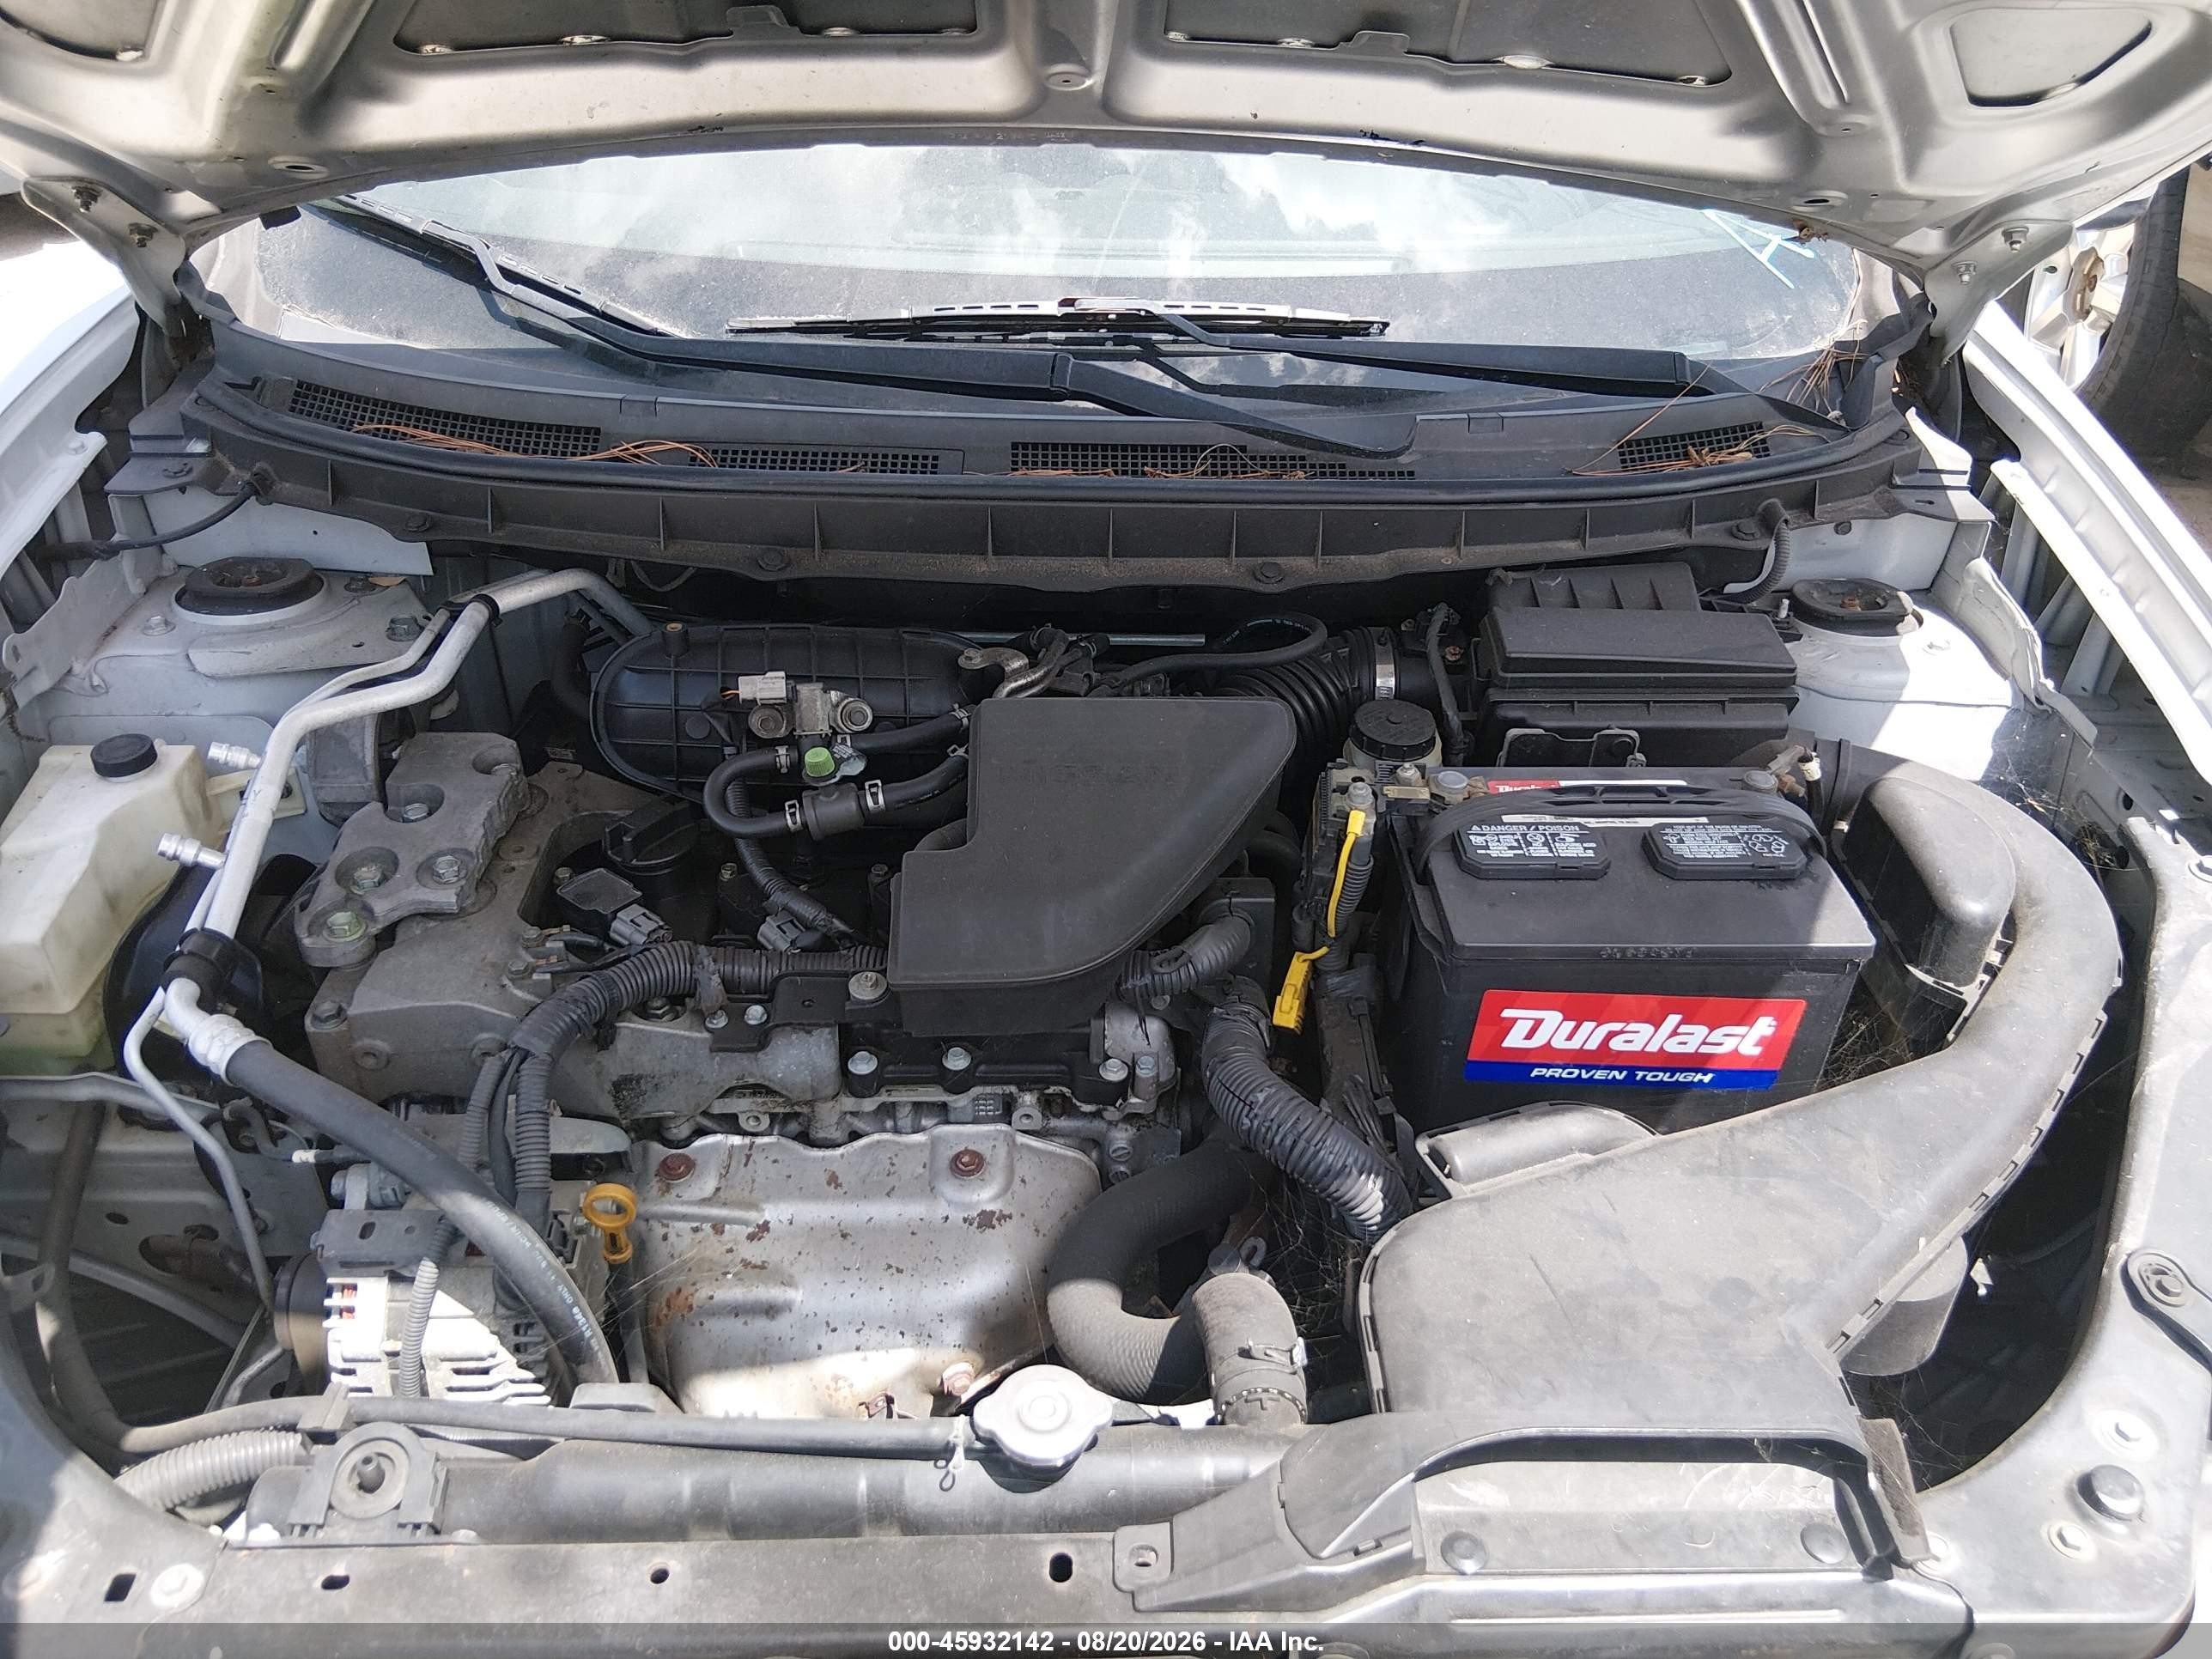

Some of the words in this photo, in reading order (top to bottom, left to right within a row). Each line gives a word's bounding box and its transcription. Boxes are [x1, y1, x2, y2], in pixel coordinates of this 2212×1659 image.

[1499, 1008, 1778, 1056] Duralast
[1530, 1067, 1627, 1080] PROVEN
[1635, 1071, 1714, 1084] TOUGH
